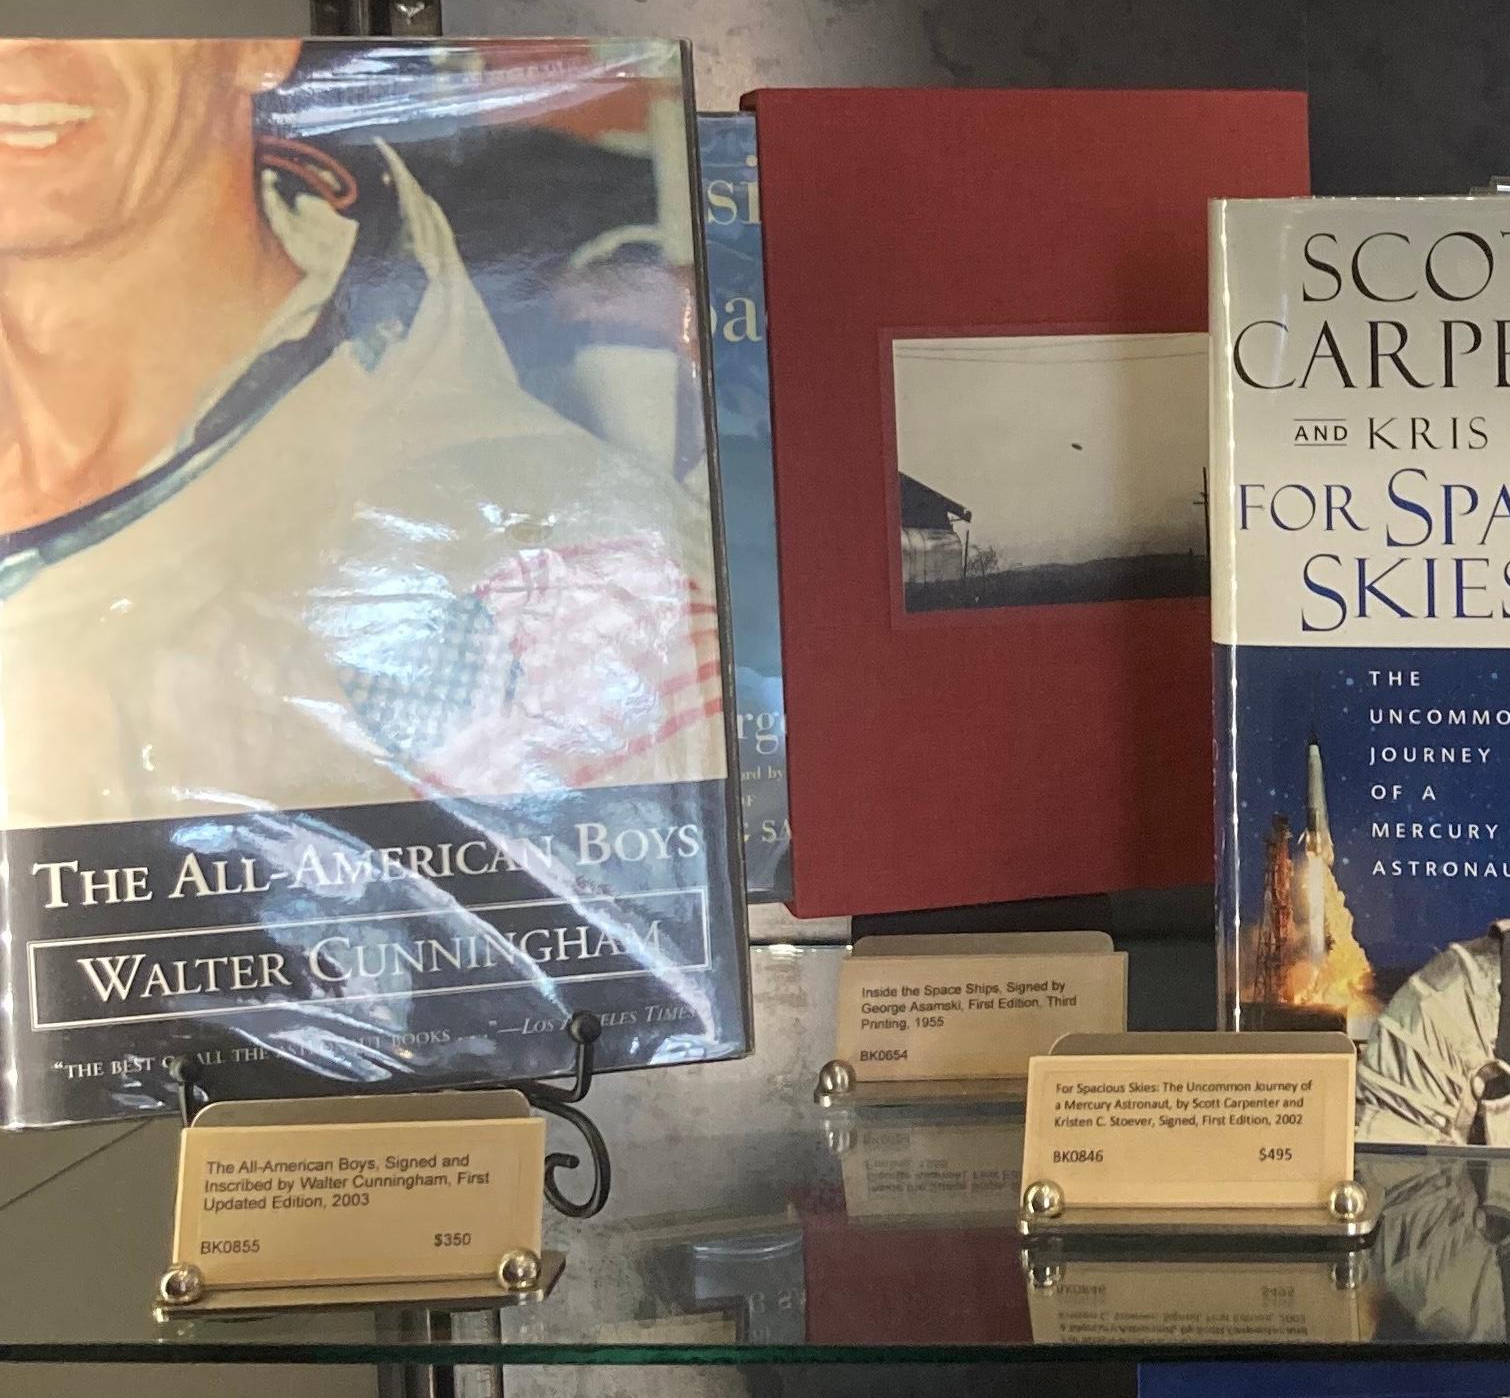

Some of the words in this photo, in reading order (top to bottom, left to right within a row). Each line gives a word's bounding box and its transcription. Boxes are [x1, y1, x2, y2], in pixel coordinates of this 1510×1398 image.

[1367, 415, 1490, 450] KRIS
[1239, 483, 1370, 533] FOR
[1369, 747, 1493, 765] JOURNEY
[1371, 822, 1501, 840] MERCURY
[31, 857, 154, 908] THE
[166, 834, 556, 903] ALL-AMERICAN
[574, 820, 700, 867] BOYS
[76, 950, 292, 1004] WALTER
[309, 920, 664, 986] CUNNINGHAM
[861, 986, 897, 998] Inside
[924, 984, 962, 998] Space
[965, 983, 1002, 996] Ships,
[1006, 980, 1048, 995] Signed
[861, 1002, 906, 1016] George
[969, 998, 994, 1010] First
[998, 997, 1043, 1010] Edition,
[1047, 996, 1077, 1008] Third
[861, 1017, 910, 1031] Printing,
[915, 1016, 945, 1028] 1955
[860, 1050, 907, 1062] BK0654
[1077, 1082, 1126, 1097] Spacious
[1129, 1081, 1159, 1093] Skies:
[1187, 1081, 1251, 1093] Uncommon
[1254, 1081, 1298, 1096] Journey
[1064, 1099, 1112, 1113] Mercury
[1114, 1098, 1172, 1113] Astronaut,
[1192, 1097, 1220, 1110] Scott
[1224, 1097, 1279, 1111] Carpenter
[1054, 1116, 1093, 1128] Kristen
[1111, 1115, 1156, 1128] Stoever,
[1159, 1114, 1198, 1129] Signed,
[1202, 1114, 1226, 1126] First
[1229, 1114, 1271, 1127] Edition,
[1275, 1113, 1303, 1126] 2002
[238, 1160, 333, 1174] All-American
[339, 1158, 380, 1173] Boys,
[386, 1155, 437, 1171] Signed
[1052, 1150, 1104, 1163] BK0846
[1259, 1148, 1292, 1161] $495
[204, 1178, 272, 1193] Inscribed
[300, 1176, 348, 1190] Walter
[352, 1174, 451, 1190] Cunningham,
[458, 1172, 490, 1185] First
[203, 1196, 266, 1214] Updated
[272, 1195, 326, 1210] Edition,
[332, 1192, 370, 1208] 2003
[200, 1240, 260, 1254] BK0855
[434, 1232, 472, 1247] $350
